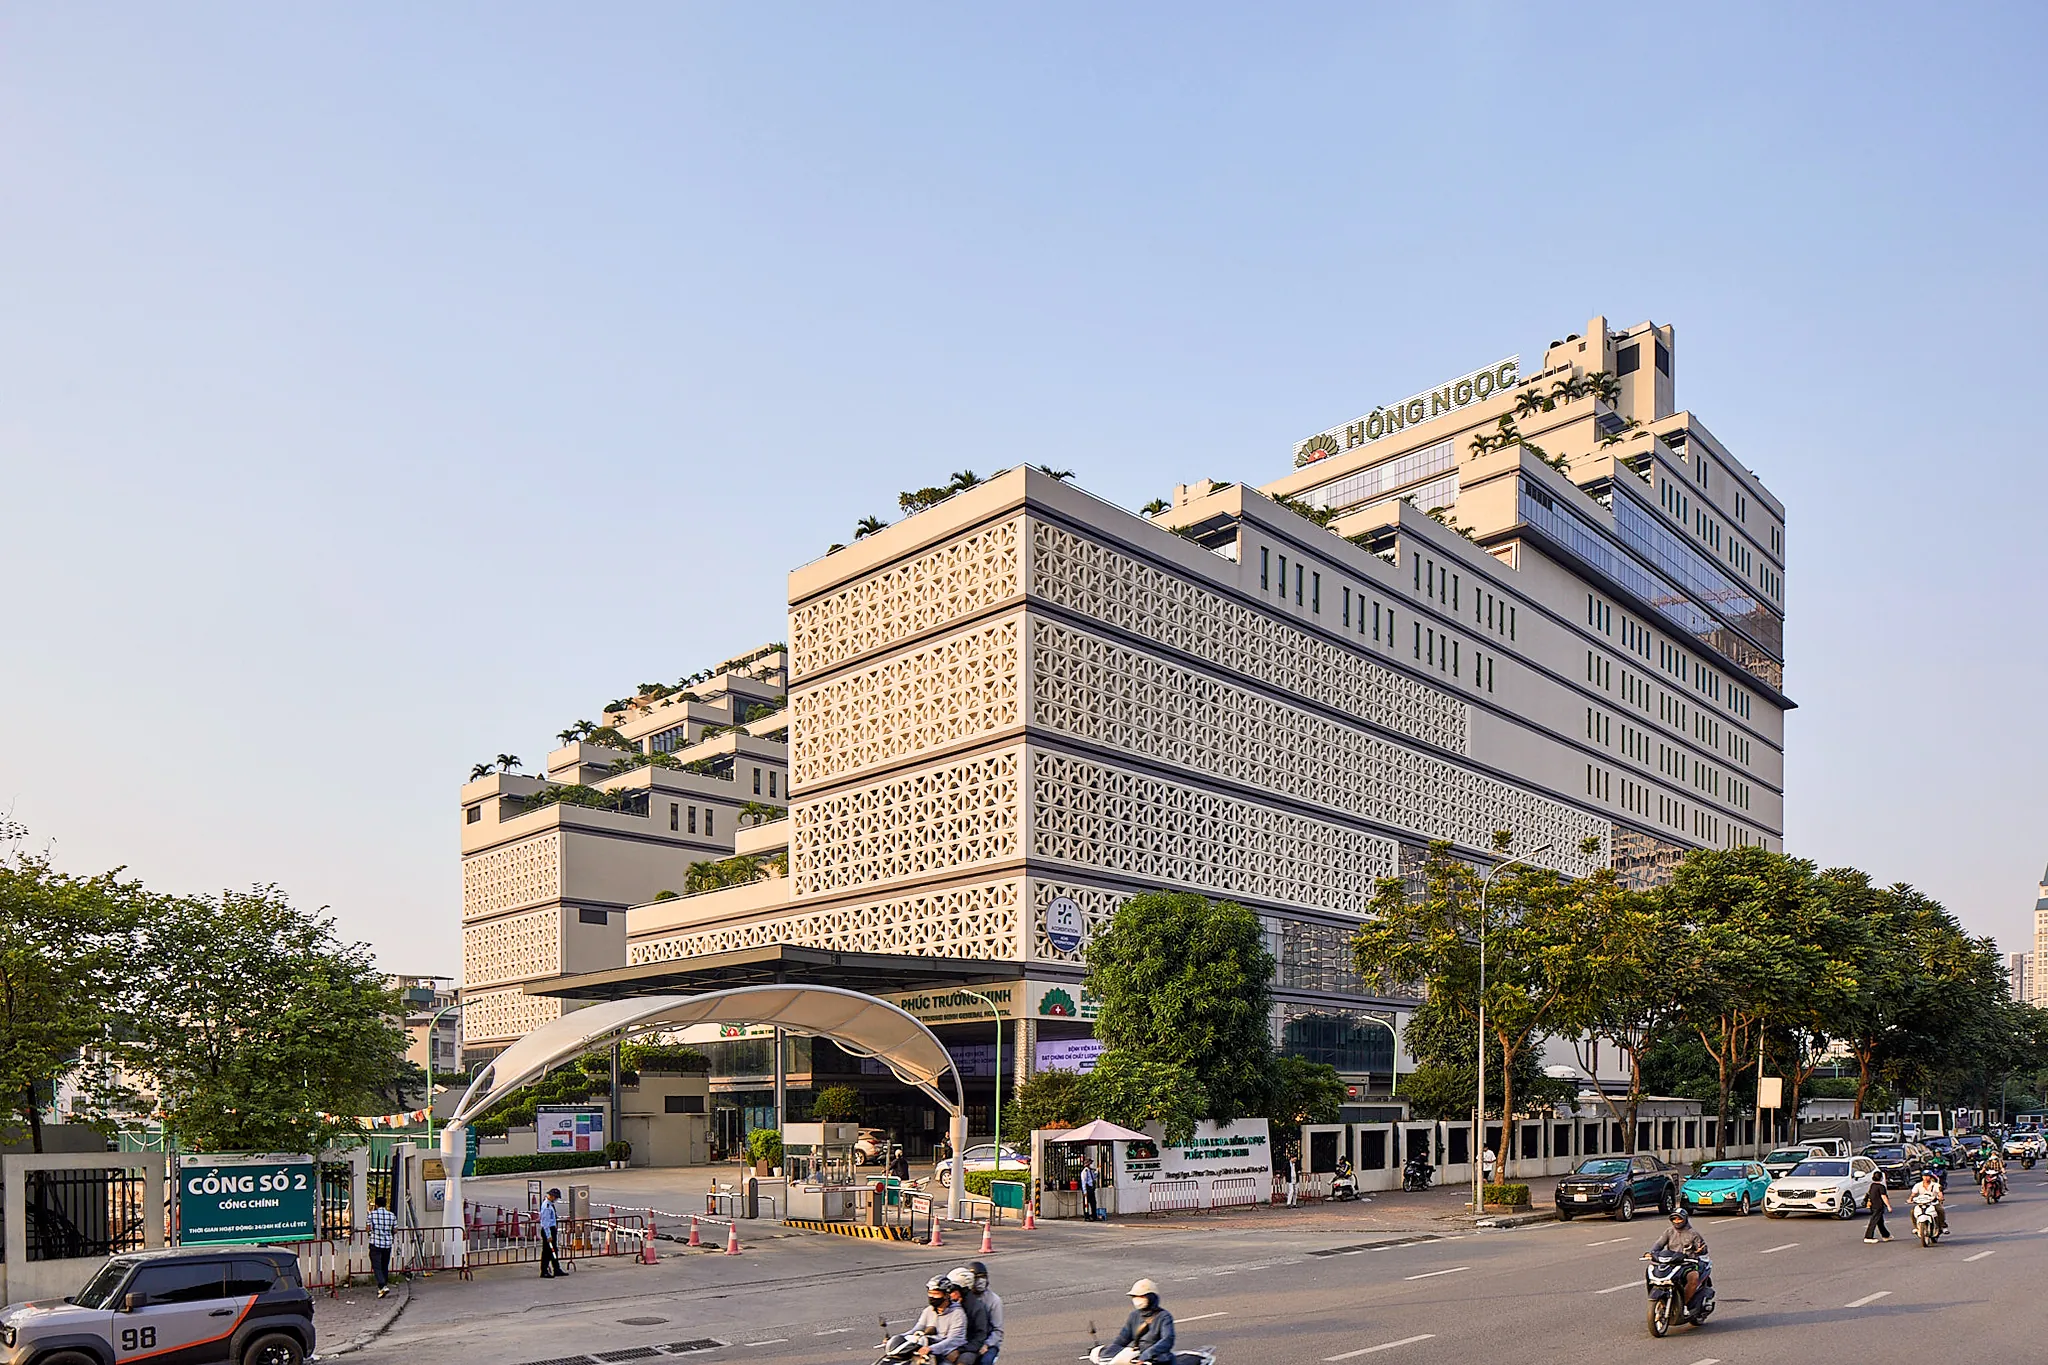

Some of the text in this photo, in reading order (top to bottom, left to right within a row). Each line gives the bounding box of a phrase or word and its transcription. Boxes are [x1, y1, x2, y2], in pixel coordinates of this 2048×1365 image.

[1346, 362, 1516, 448] HỒNG NGỌC
[901, 994, 931, 1011] PHÚC
[932, 990, 978, 1009] TRƯỜNG
[981, 989, 1012, 1004] MINH
[1958, 1107, 1968, 1118] P
[188, 1167, 307, 1195] CỔNG SỐ 2
[248, 1197, 279, 1208] CHÍNH
[122, 1326, 157, 1351] 98
